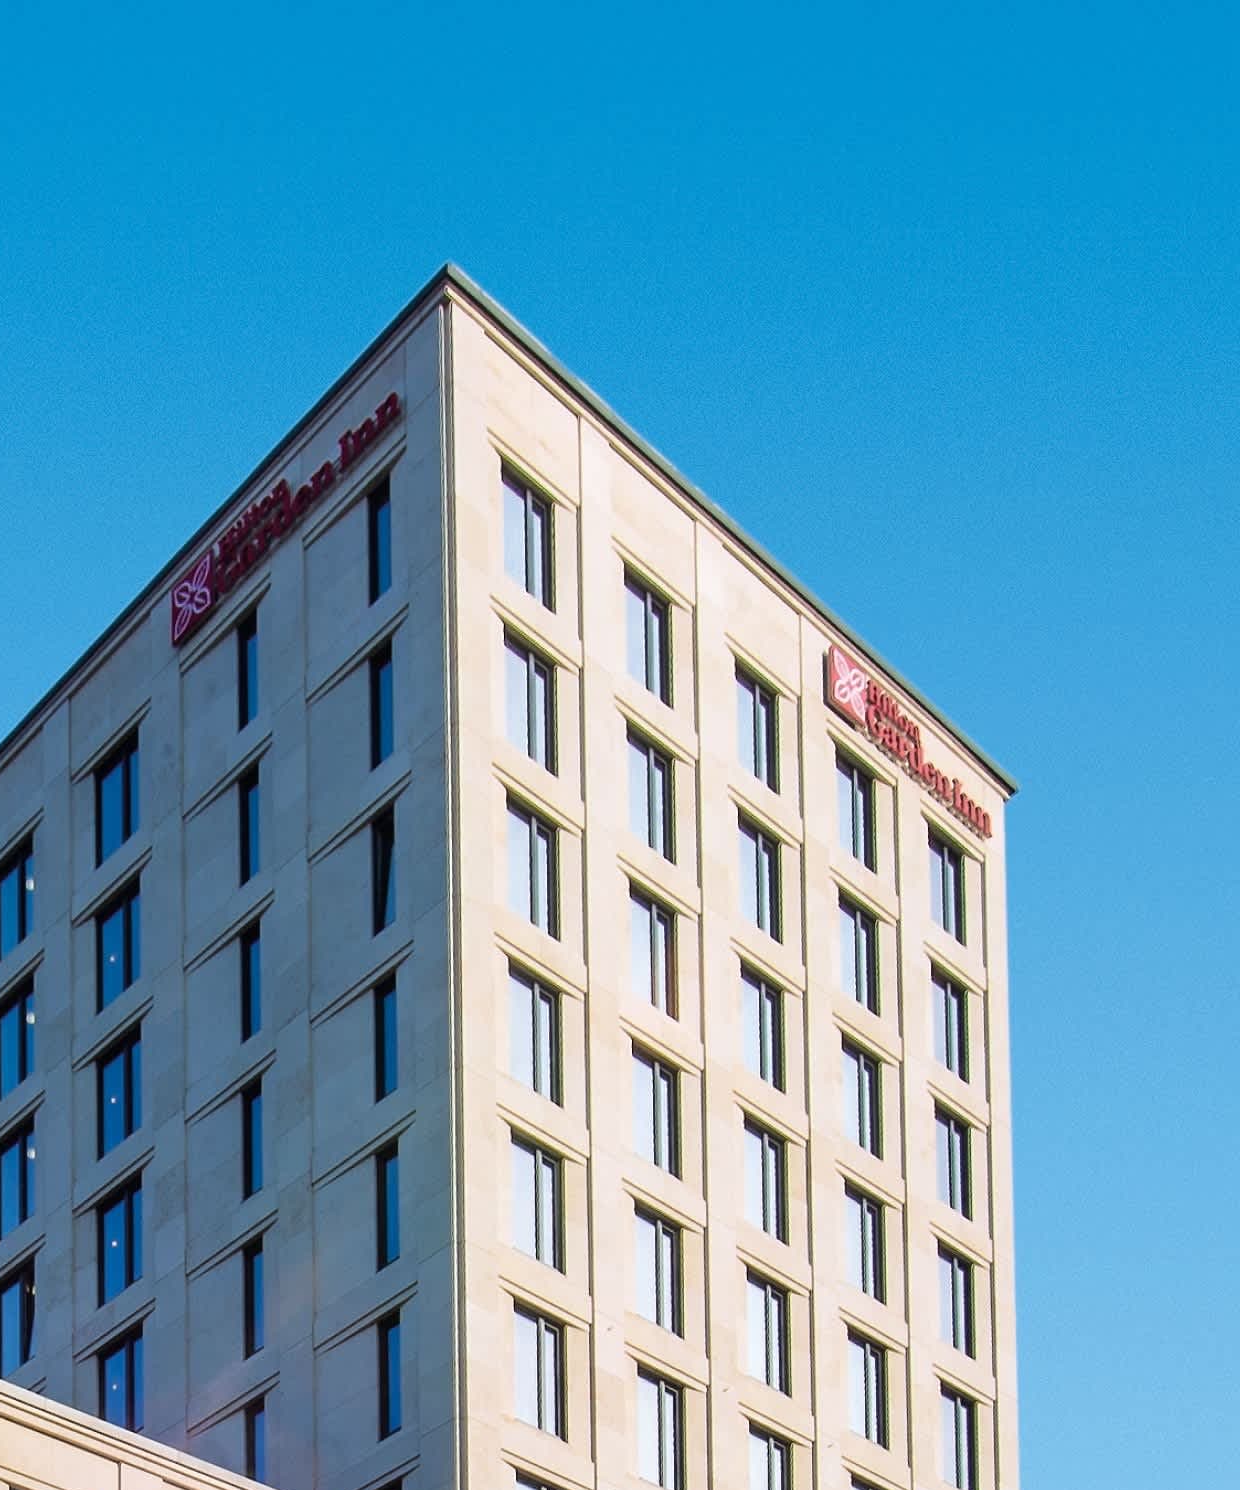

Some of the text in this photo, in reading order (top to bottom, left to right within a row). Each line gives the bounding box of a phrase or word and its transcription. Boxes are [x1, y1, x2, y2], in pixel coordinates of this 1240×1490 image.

[338, 392, 401, 472] Inn
[865, 702, 992, 838] Garden Inn
